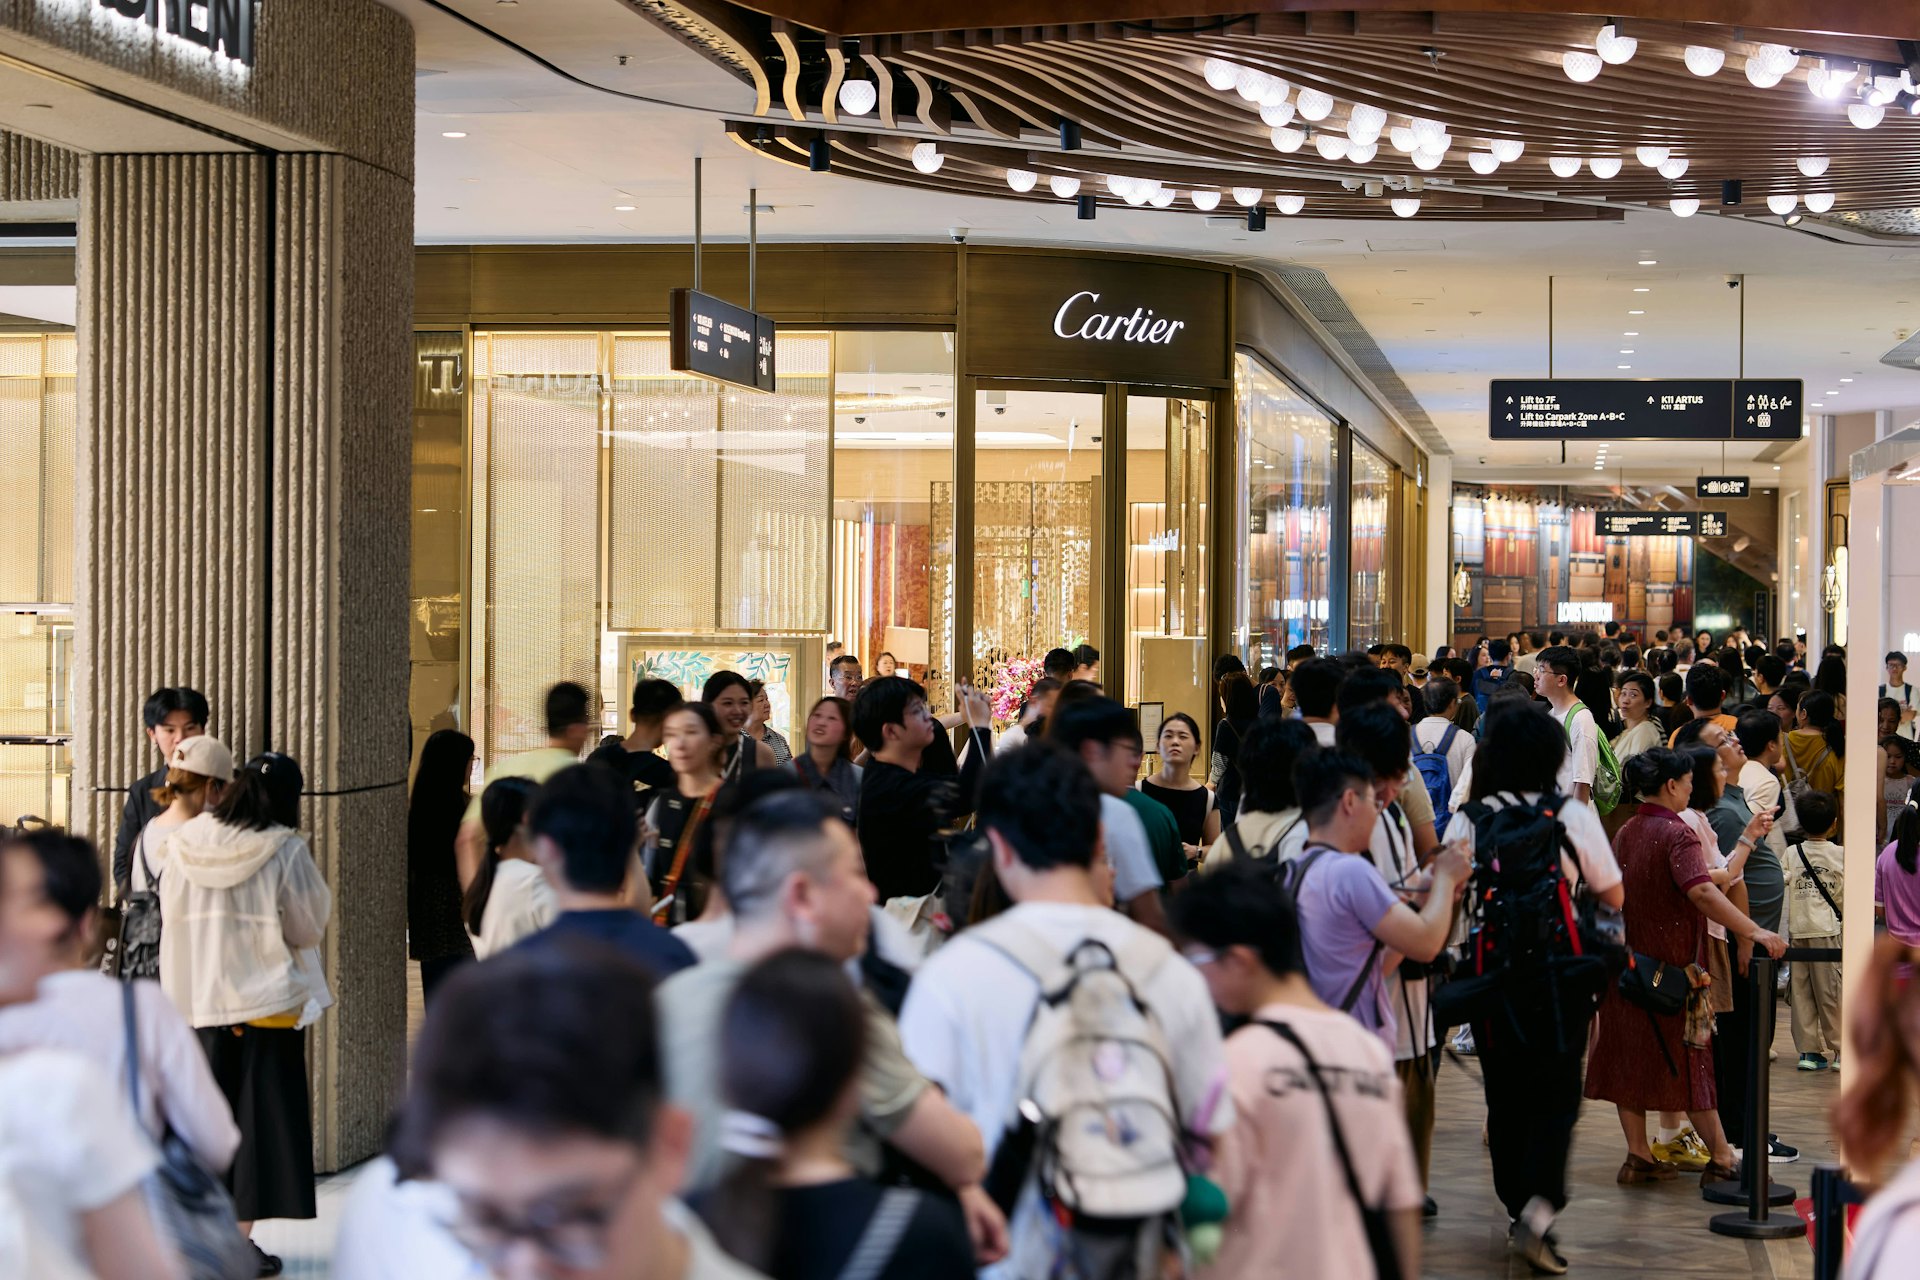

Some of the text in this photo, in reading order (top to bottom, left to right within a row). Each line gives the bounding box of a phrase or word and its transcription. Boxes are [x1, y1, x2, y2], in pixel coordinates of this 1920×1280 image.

[1053, 291, 1185, 344] Cartier
[1520, 395, 1556, 404] Lift to 7F
[1661, 395, 1704, 404] K11 ARTUS
[1520, 412, 1534, 421] Lift
[1535, 413, 1545, 421] to
[1545, 412, 1577, 422] Carpark
[1578, 412, 1599, 421] Zone
